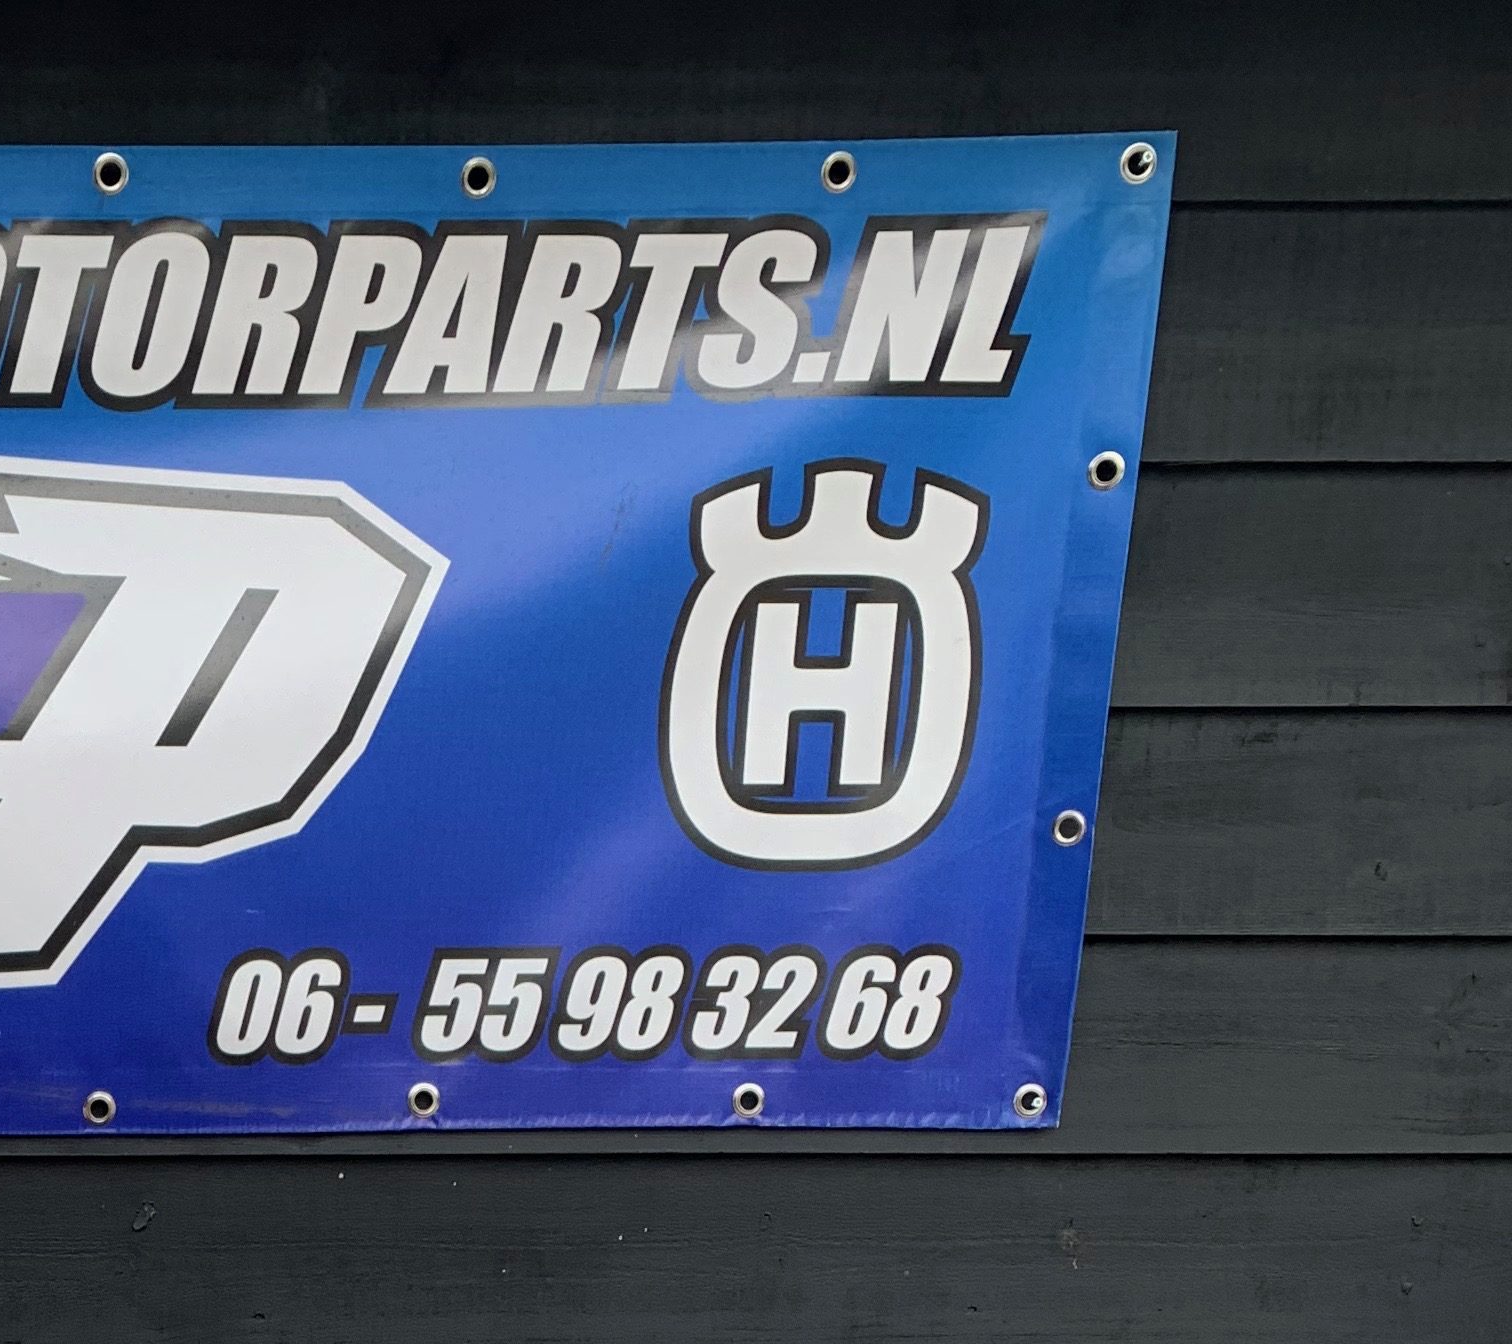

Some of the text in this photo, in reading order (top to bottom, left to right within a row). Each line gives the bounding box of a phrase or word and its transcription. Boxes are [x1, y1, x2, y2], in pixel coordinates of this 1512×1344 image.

[418, 957, 546, 1055] 55
[555, 953, 681, 1055] 98
[690, 953, 810, 1052] 32
[821, 952, 955, 1053] 68
